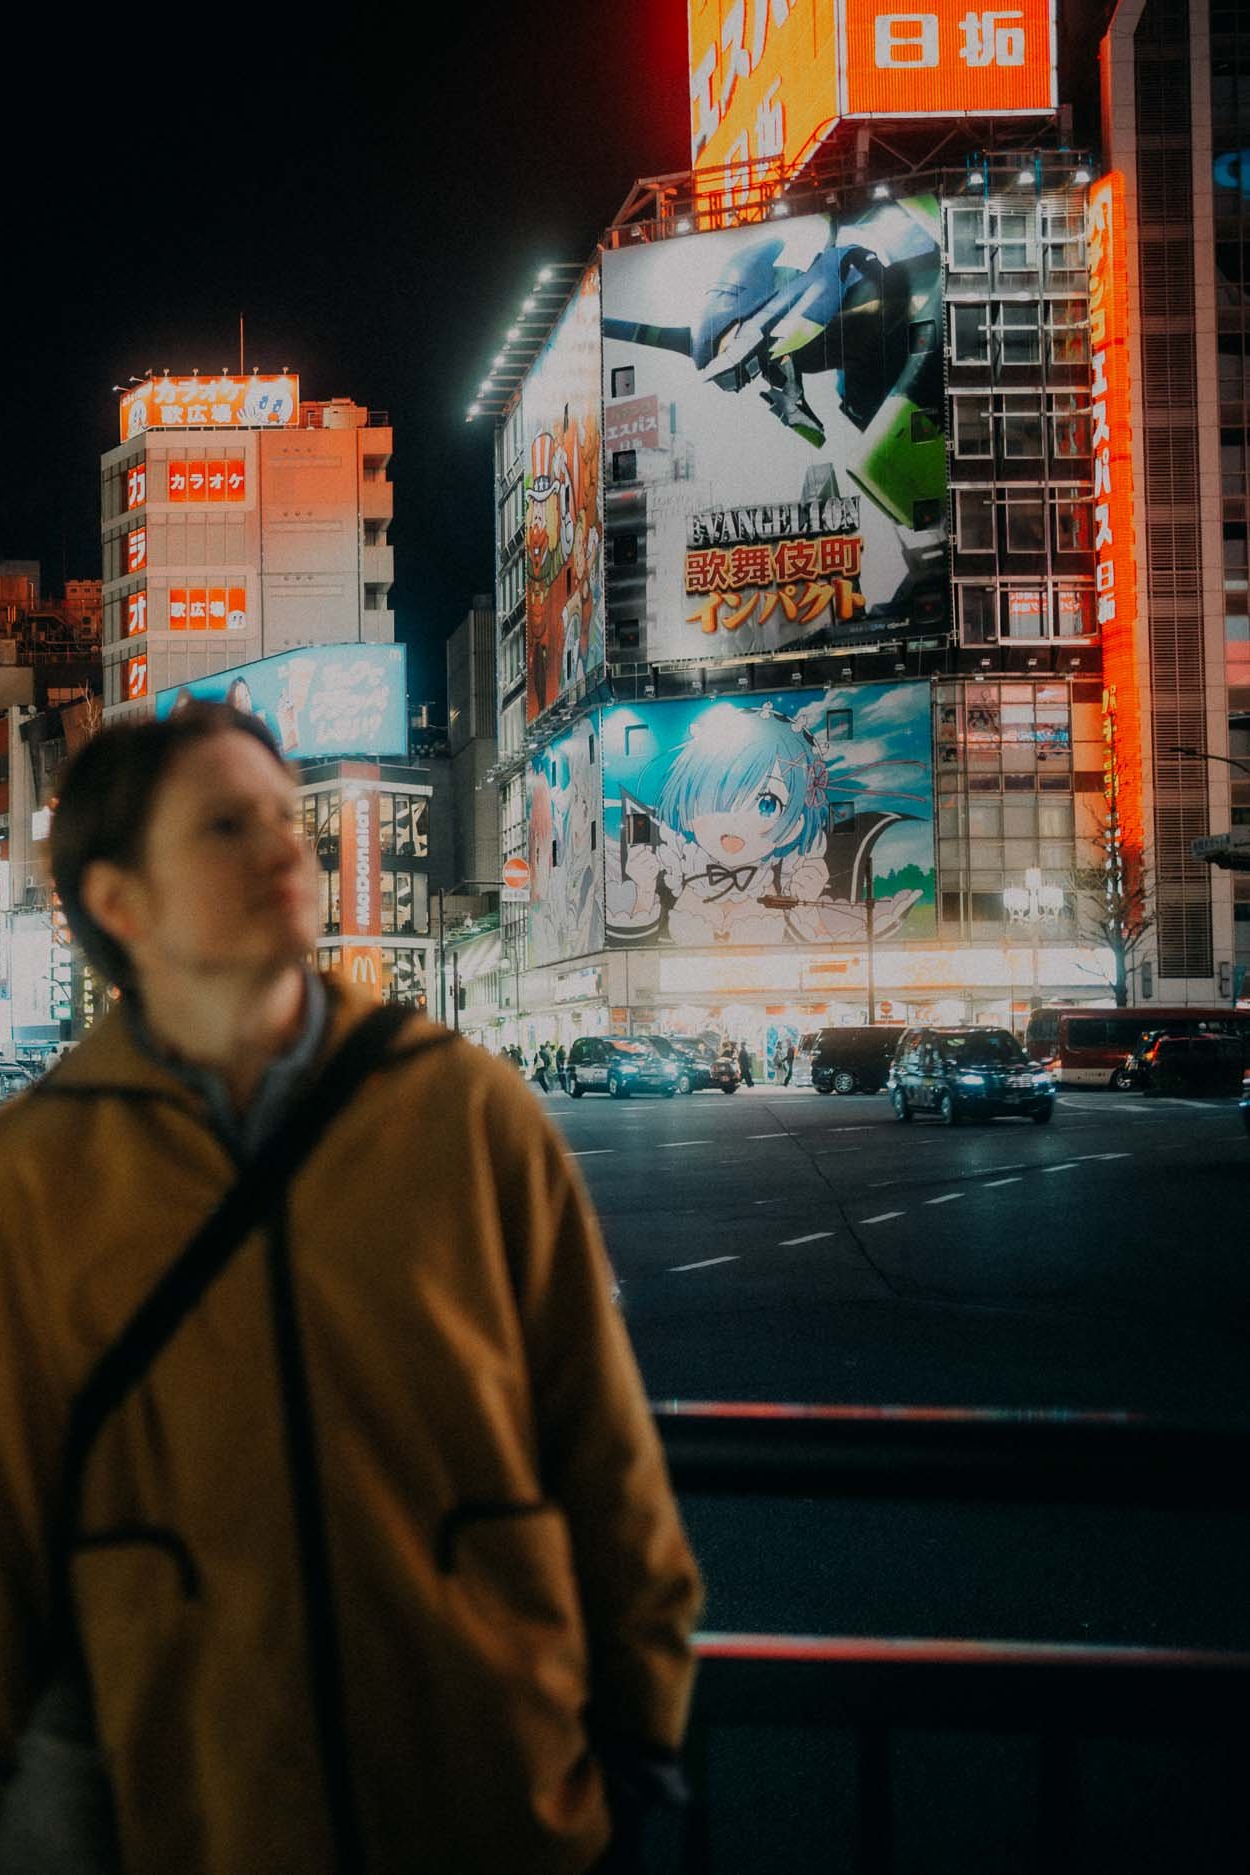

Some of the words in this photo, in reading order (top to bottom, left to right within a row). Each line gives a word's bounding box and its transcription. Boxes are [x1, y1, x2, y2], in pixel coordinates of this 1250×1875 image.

[874, 10, 1025, 69] 日拓
[154, 378, 246, 404] カラオケ
[160, 403, 232, 424] 歌広場
[607, 414, 657, 441] エスパス
[1091, 350, 1113, 552] エスパス
[170, 473, 244, 490] カラオケ
[690, 496, 862, 547] EVANGELION
[128, 470, 147, 696] カラオケ
[686, 536, 864, 594] 歌舞伎町
[170, 600, 226, 618] 歌広場
[686, 578, 867, 634] インパクト
